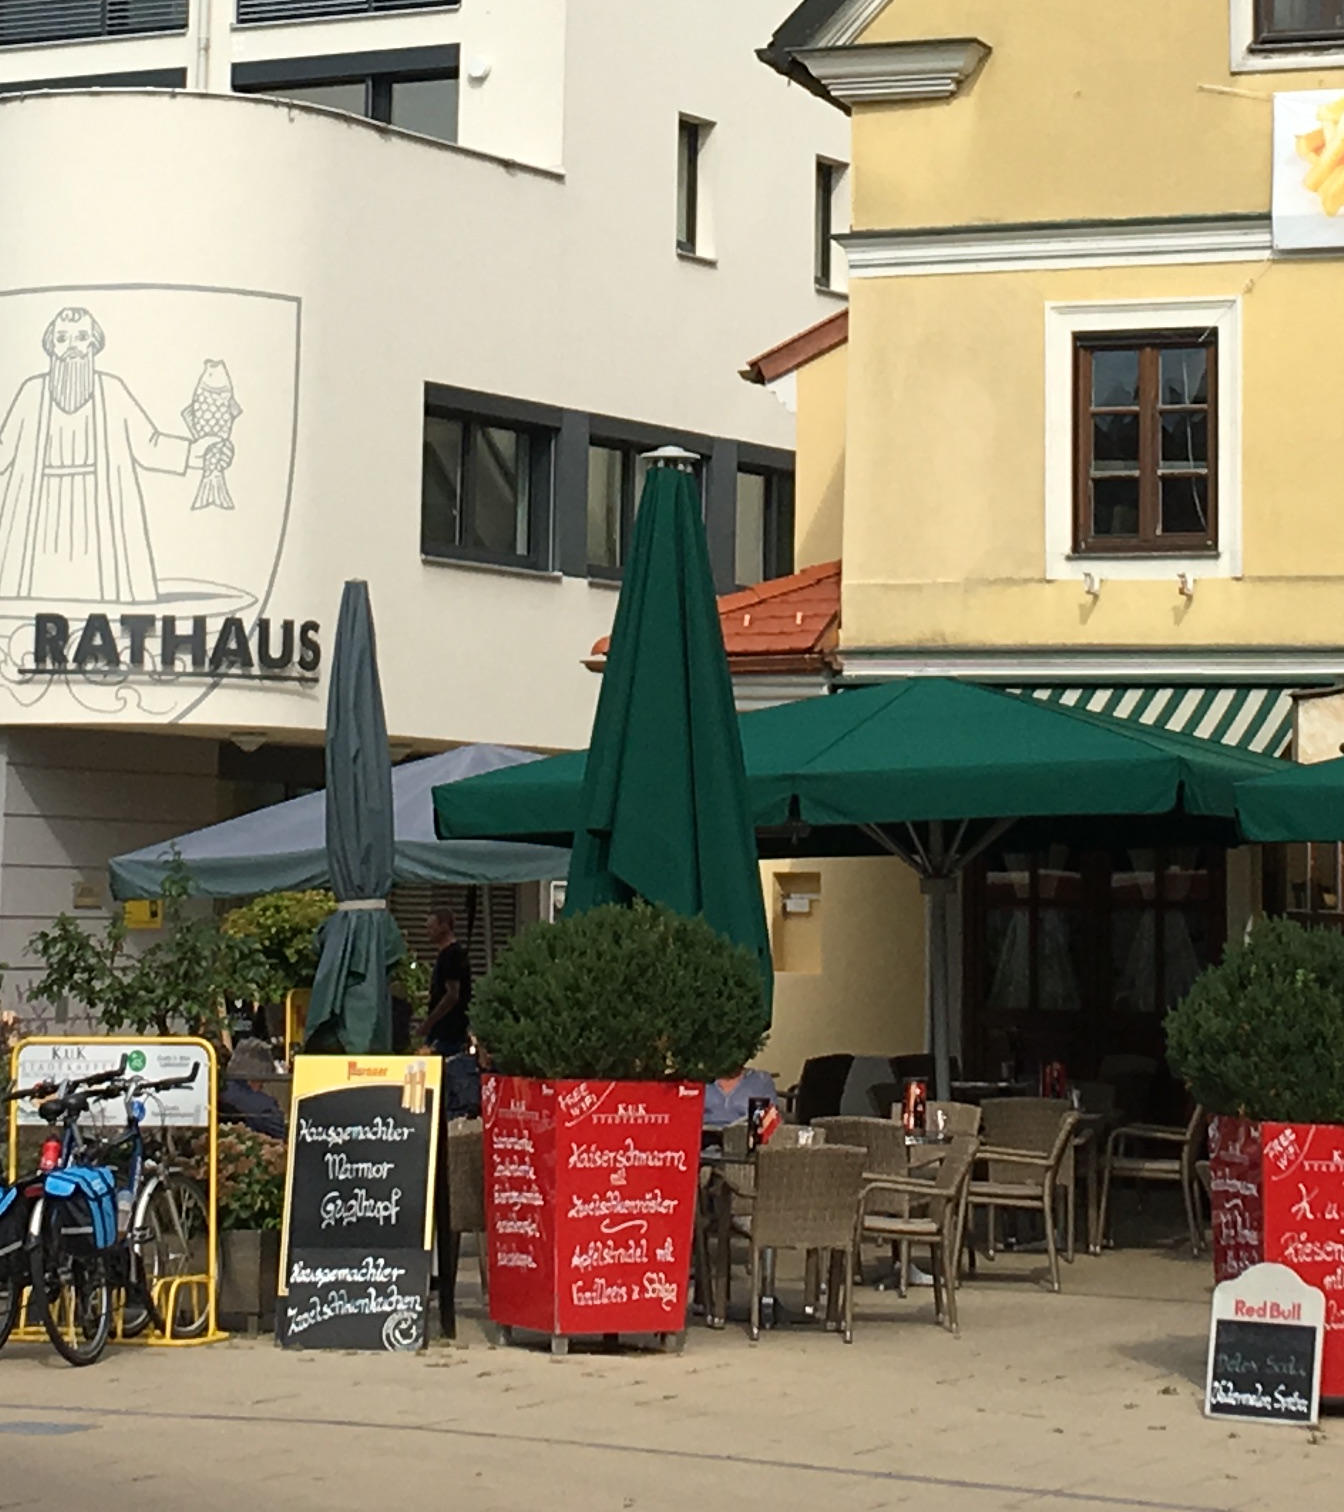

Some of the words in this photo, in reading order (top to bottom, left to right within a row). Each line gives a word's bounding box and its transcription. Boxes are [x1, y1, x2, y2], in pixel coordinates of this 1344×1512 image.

[35, 613, 321, 671] RATHAUS
[324, 1153, 394, 1180] Marmor
[1234, 1299, 1267, 1317] Red
[1269, 1301, 1302, 1320] Bull
